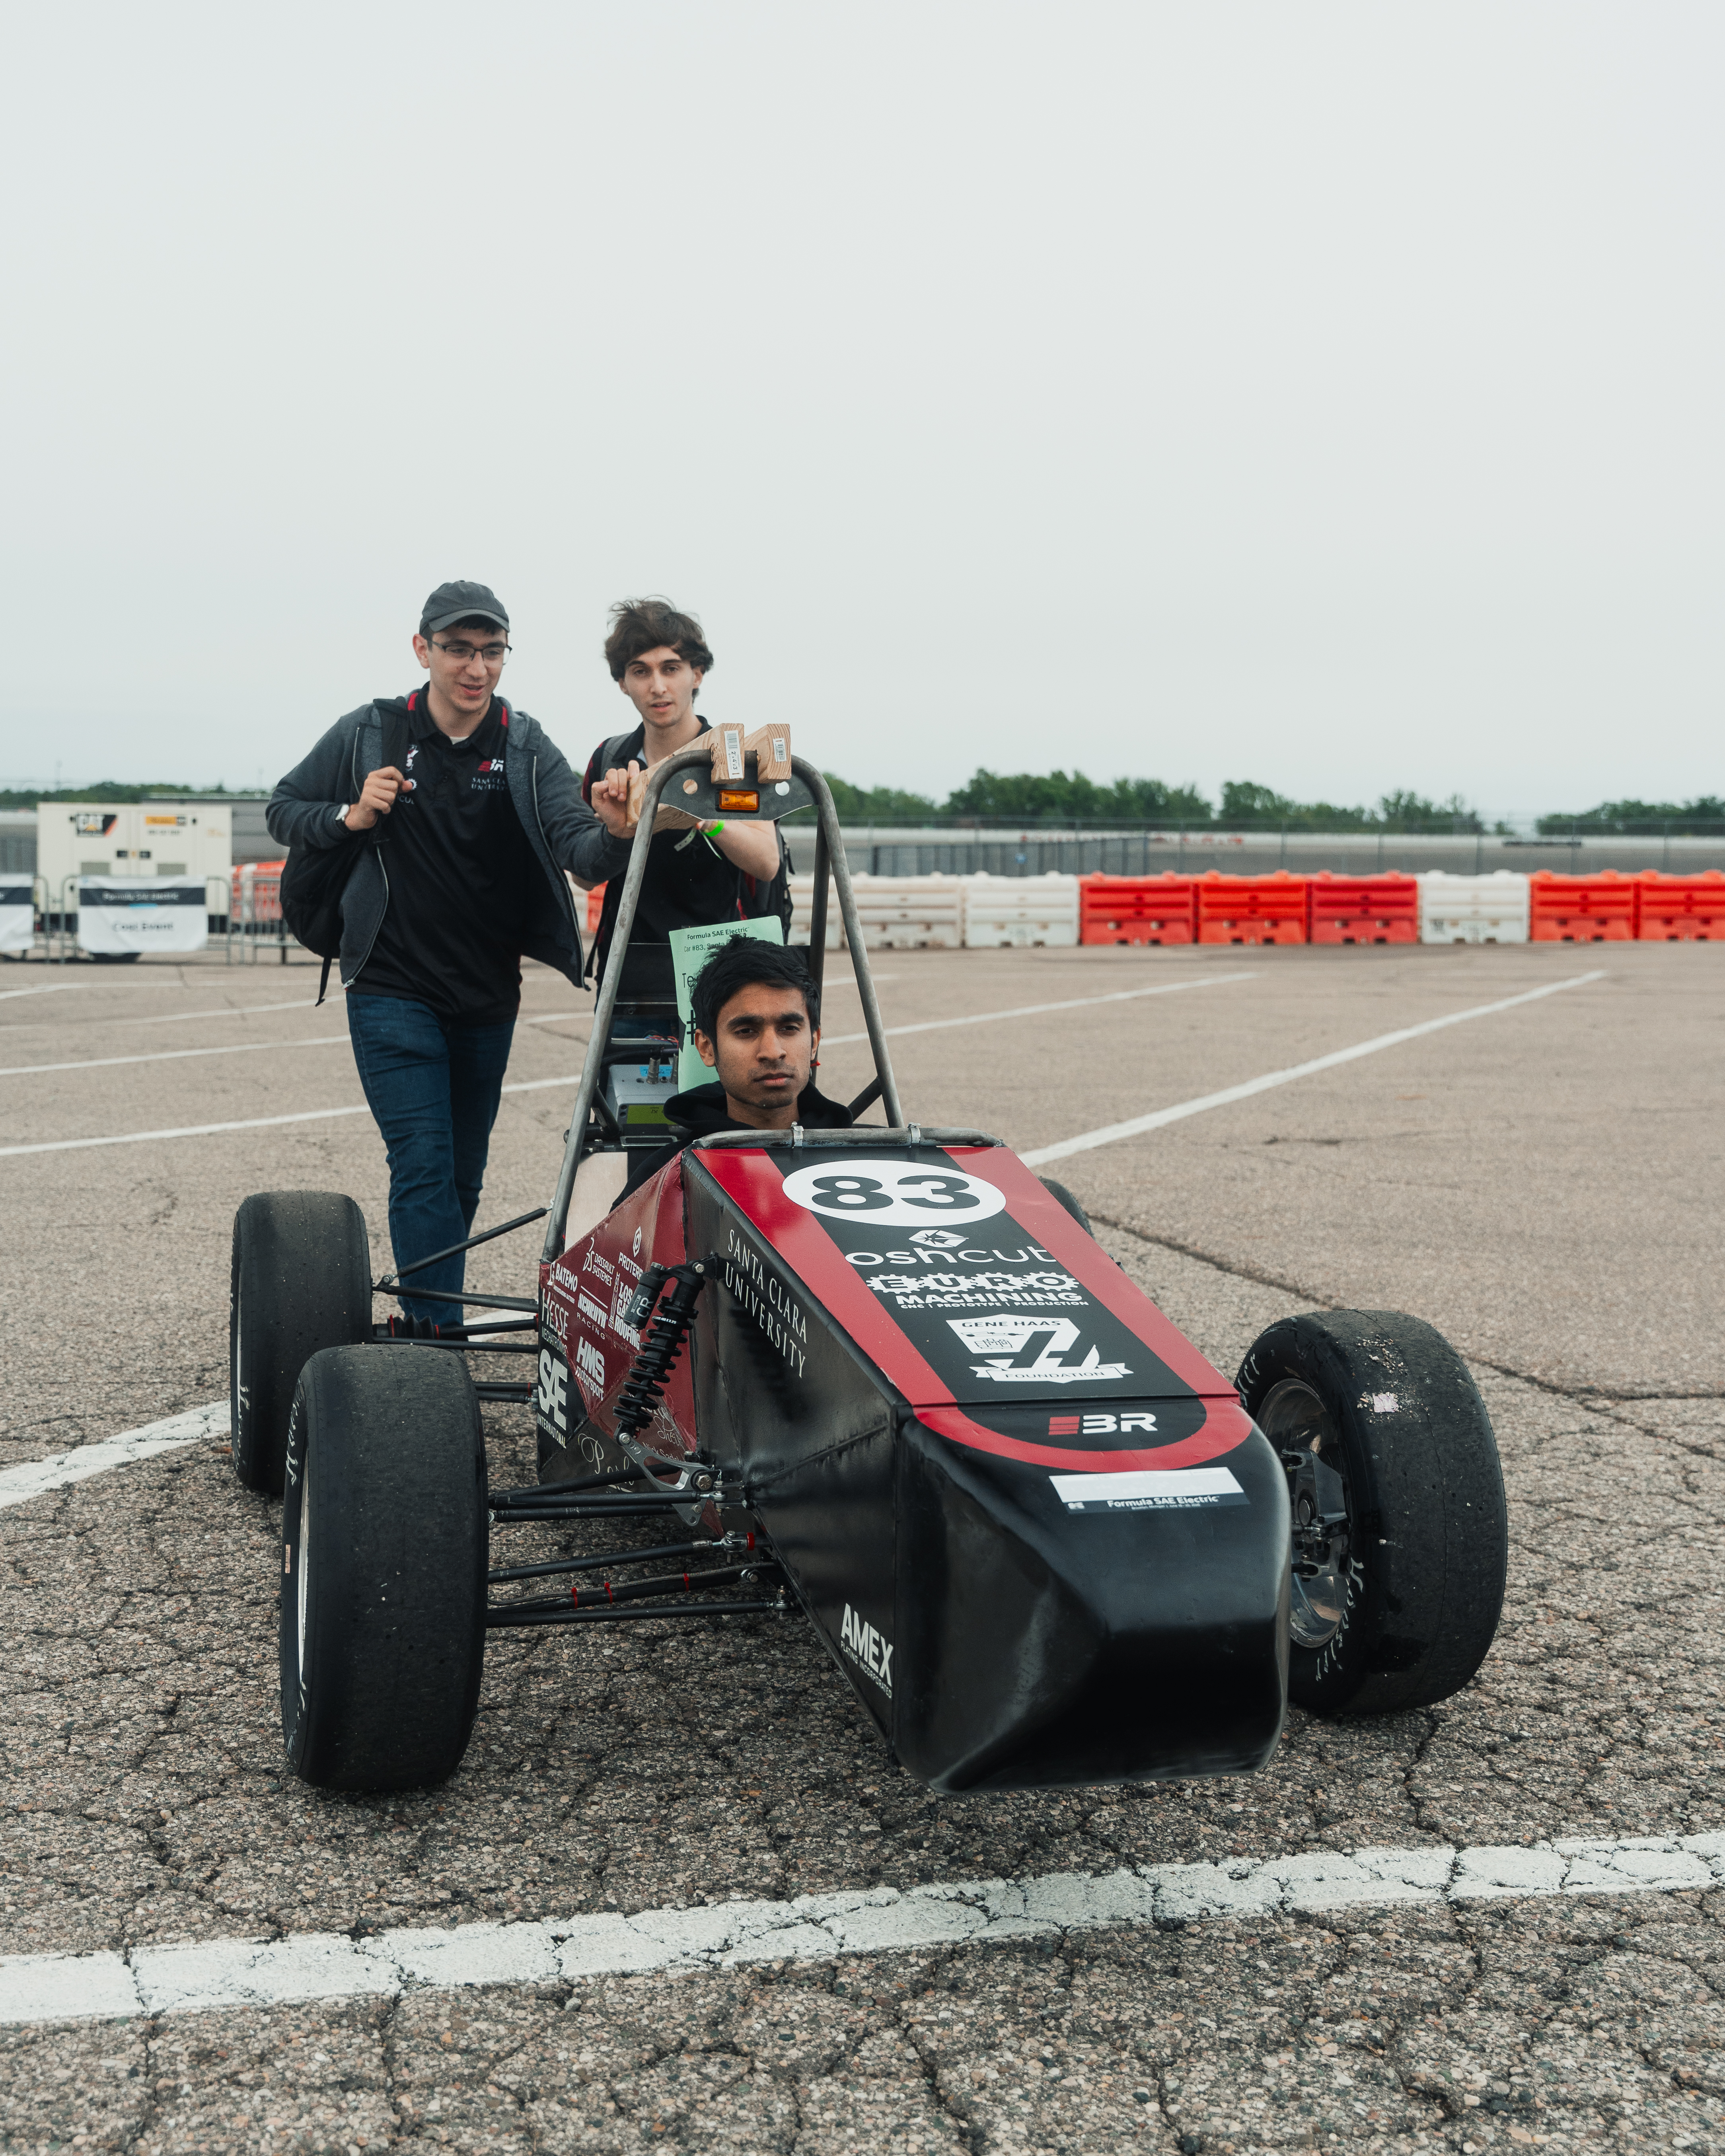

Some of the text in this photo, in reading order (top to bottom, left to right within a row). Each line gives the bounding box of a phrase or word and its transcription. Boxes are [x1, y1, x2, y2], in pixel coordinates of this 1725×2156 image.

[812, 1175, 980, 1210] 83
[594, 1253, 615, 1275] DASSAULT
[845, 1246, 1057, 1266] oshcut
[555, 1263, 578, 1292] BATEMO
[618, 1281, 633, 1305] LOS
[728, 1229, 807, 1344] SANTA CLARA
[872, 1274, 1073, 1291] EURO
[541, 1288, 569, 1341] HESSE
[636, 1297, 654, 1318] CR
[896, 1292, 1083, 1305] MACHINING
[577, 1312, 605, 1340] RACING
[614, 1314, 641, 1351] ROOFING
[726, 1261, 806, 1378] UNIVERSITY
[576, 1336, 605, 1385] HMS
[538, 1349, 567, 1430] SAE
[575, 1365, 604, 1401] motorsport
[537, 1413, 567, 1449] INTERNATIONAL
[1107, 1498, 1153, 1508] Formula
[1153, 1496, 1176, 1505] SAE
[841, 1603, 894, 1687] AMEX
[841, 1640, 892, 1699] PLATING INCORPORATED
